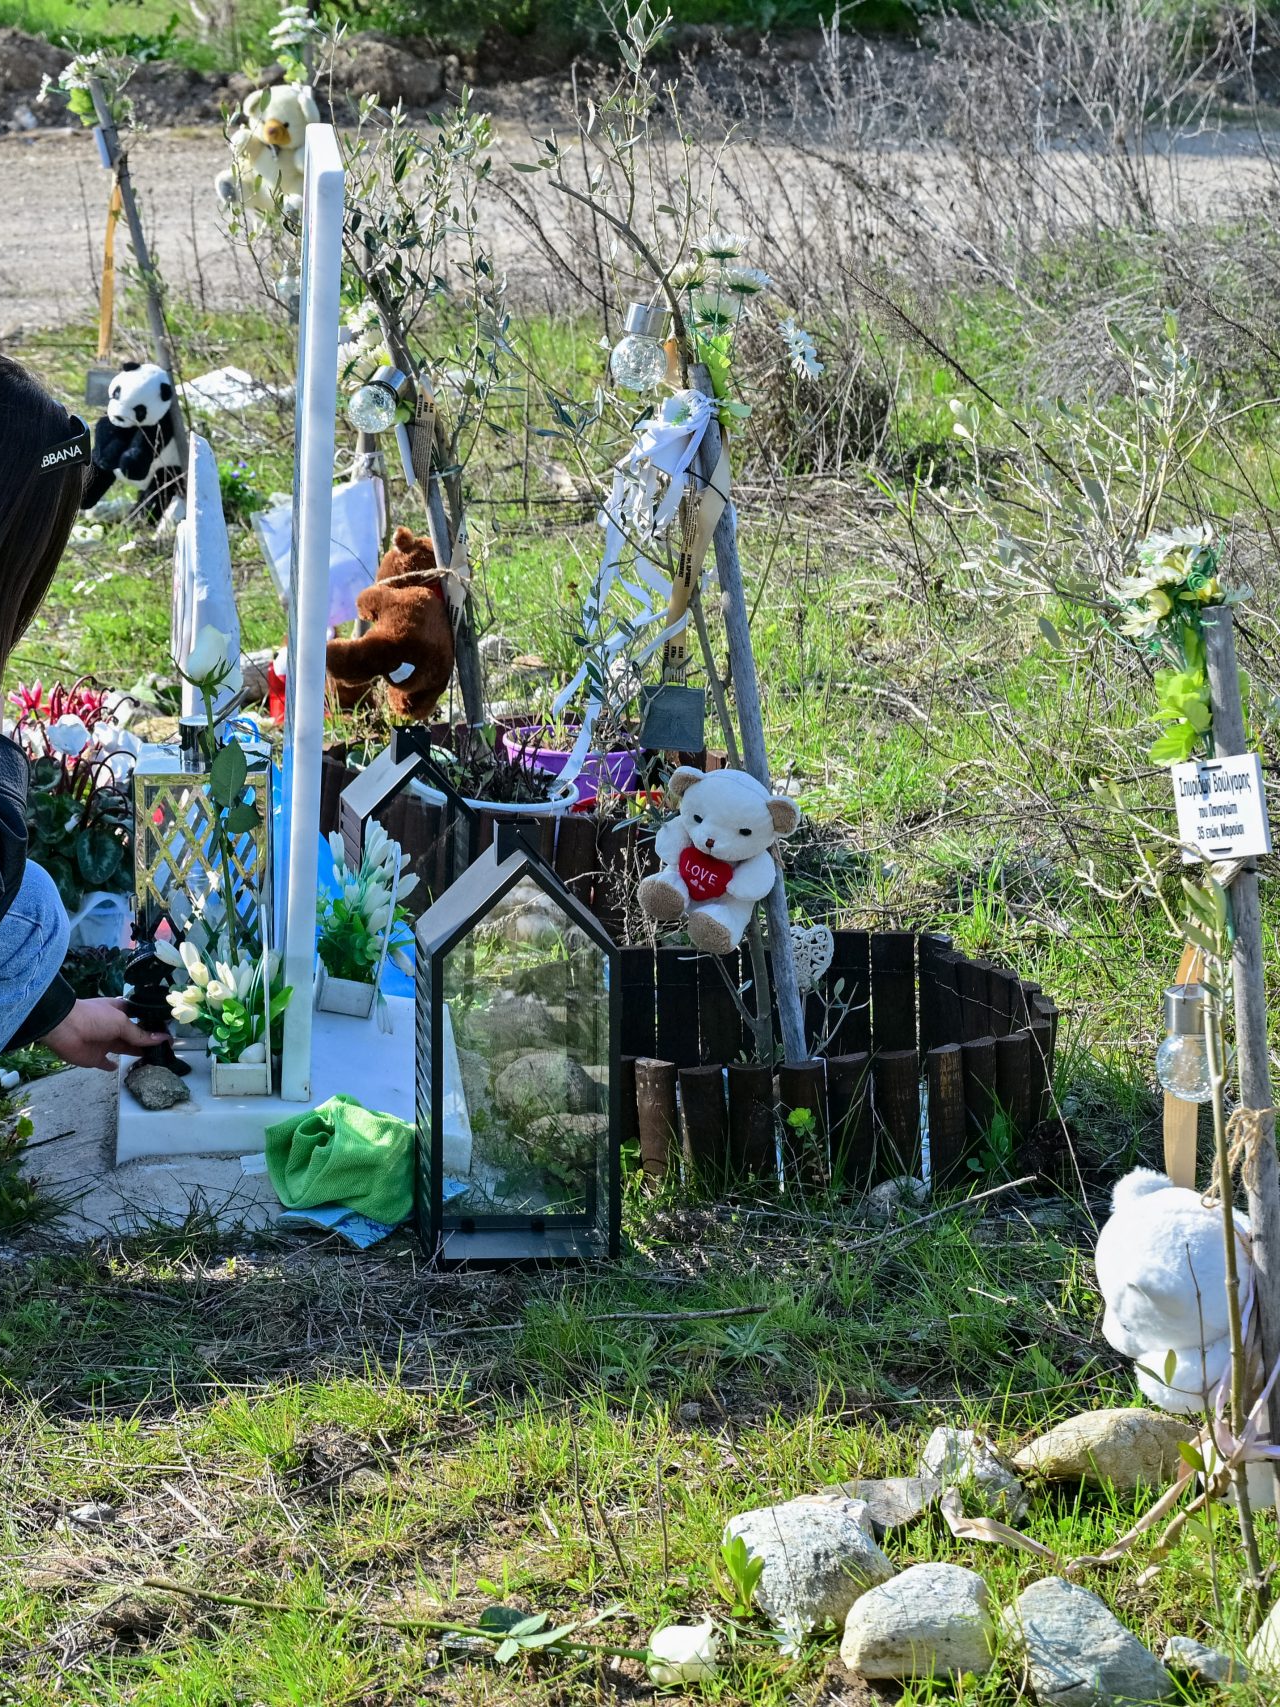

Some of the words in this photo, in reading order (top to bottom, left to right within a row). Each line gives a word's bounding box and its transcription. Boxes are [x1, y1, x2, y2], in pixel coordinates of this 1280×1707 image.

[1179, 775, 1211, 800] Σπυρίδων
[1213, 771, 1252, 796] Βούλγαρης
[1199, 807, 1208, 818] του
[1197, 826, 1205, 840] 35
[685, 860, 718, 887] LOVE
